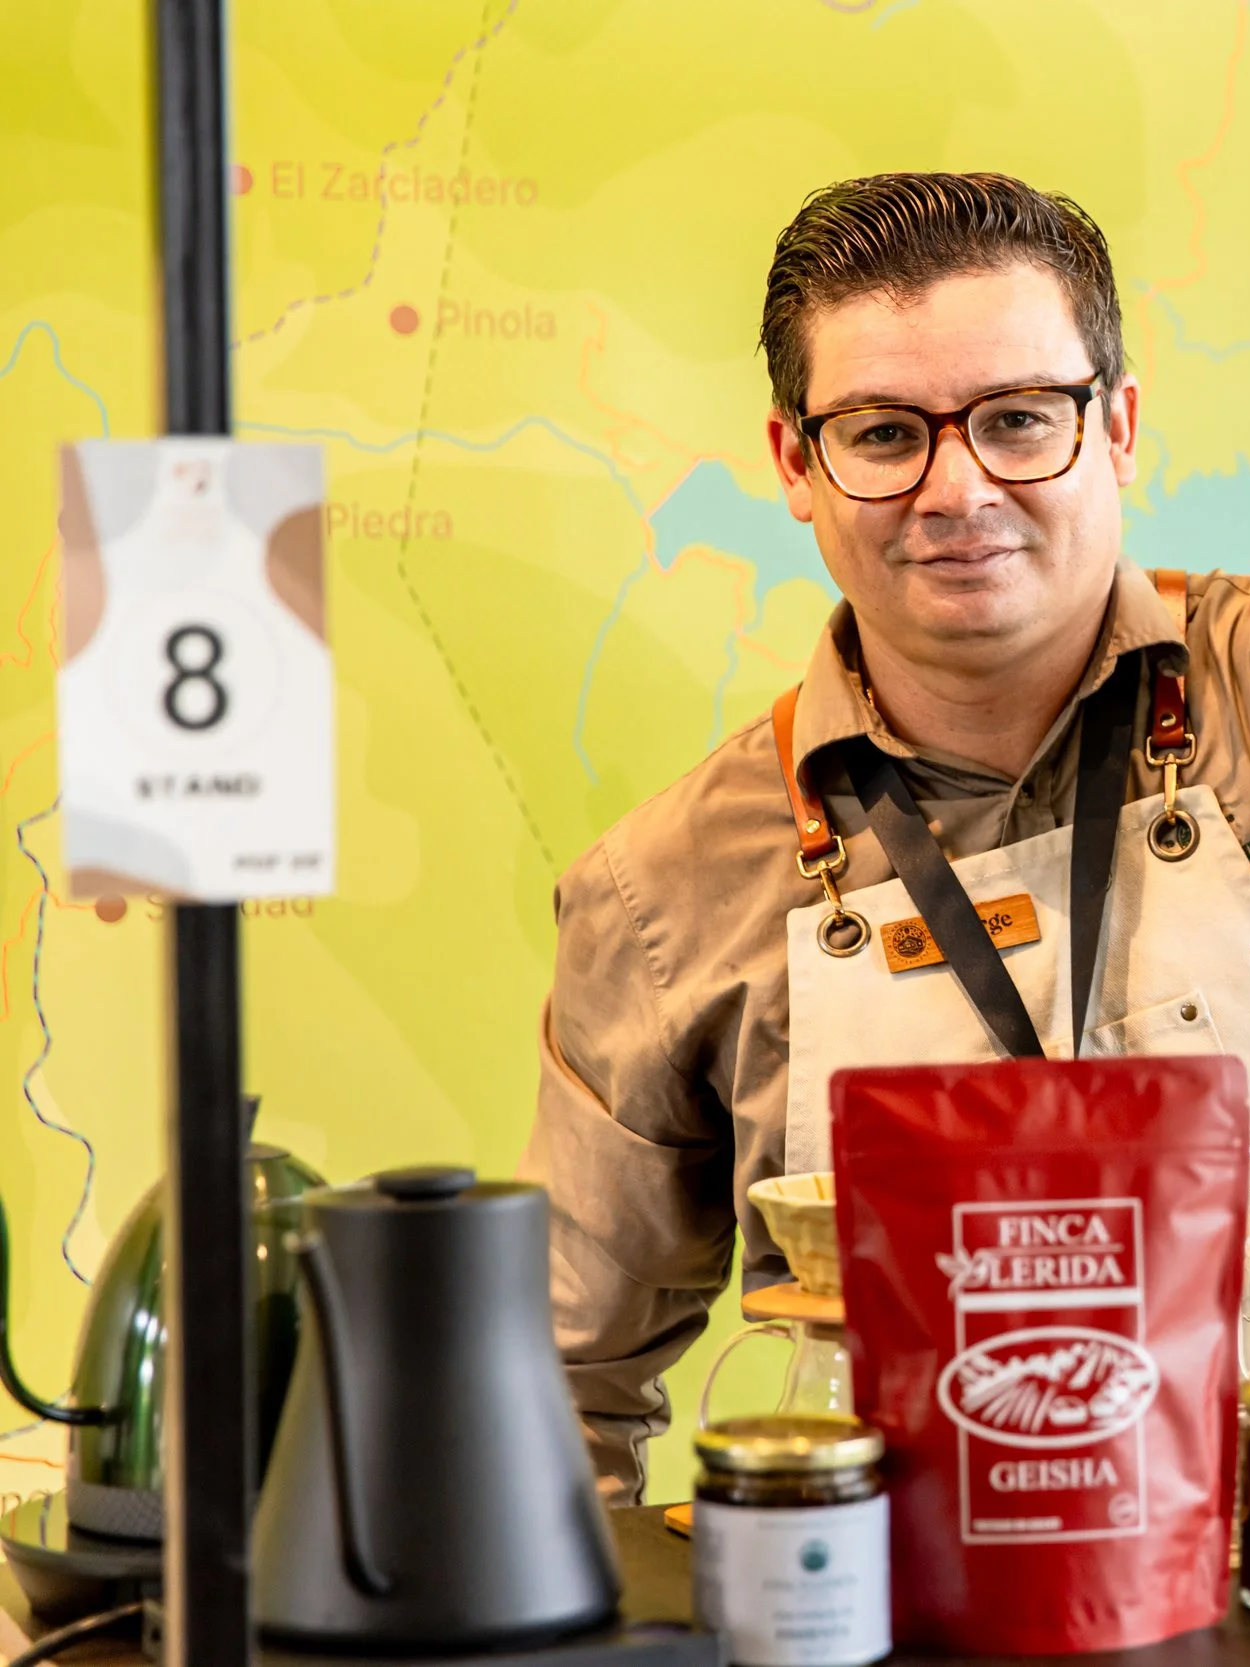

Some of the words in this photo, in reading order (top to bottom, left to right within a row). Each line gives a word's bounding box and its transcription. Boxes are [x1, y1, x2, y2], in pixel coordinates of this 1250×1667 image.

[272, 161, 304, 198] El
[321, 162, 538, 207] Zarciadero
[437, 302, 557, 340] Pinola
[325, 504, 453, 541] Piedra
[164, 624, 228, 731] 8
[999, 1214, 1110, 1247] FINCA
[988, 1254, 1123, 1288] LERIDA
[989, 1458, 1119, 1492] GEISHA
